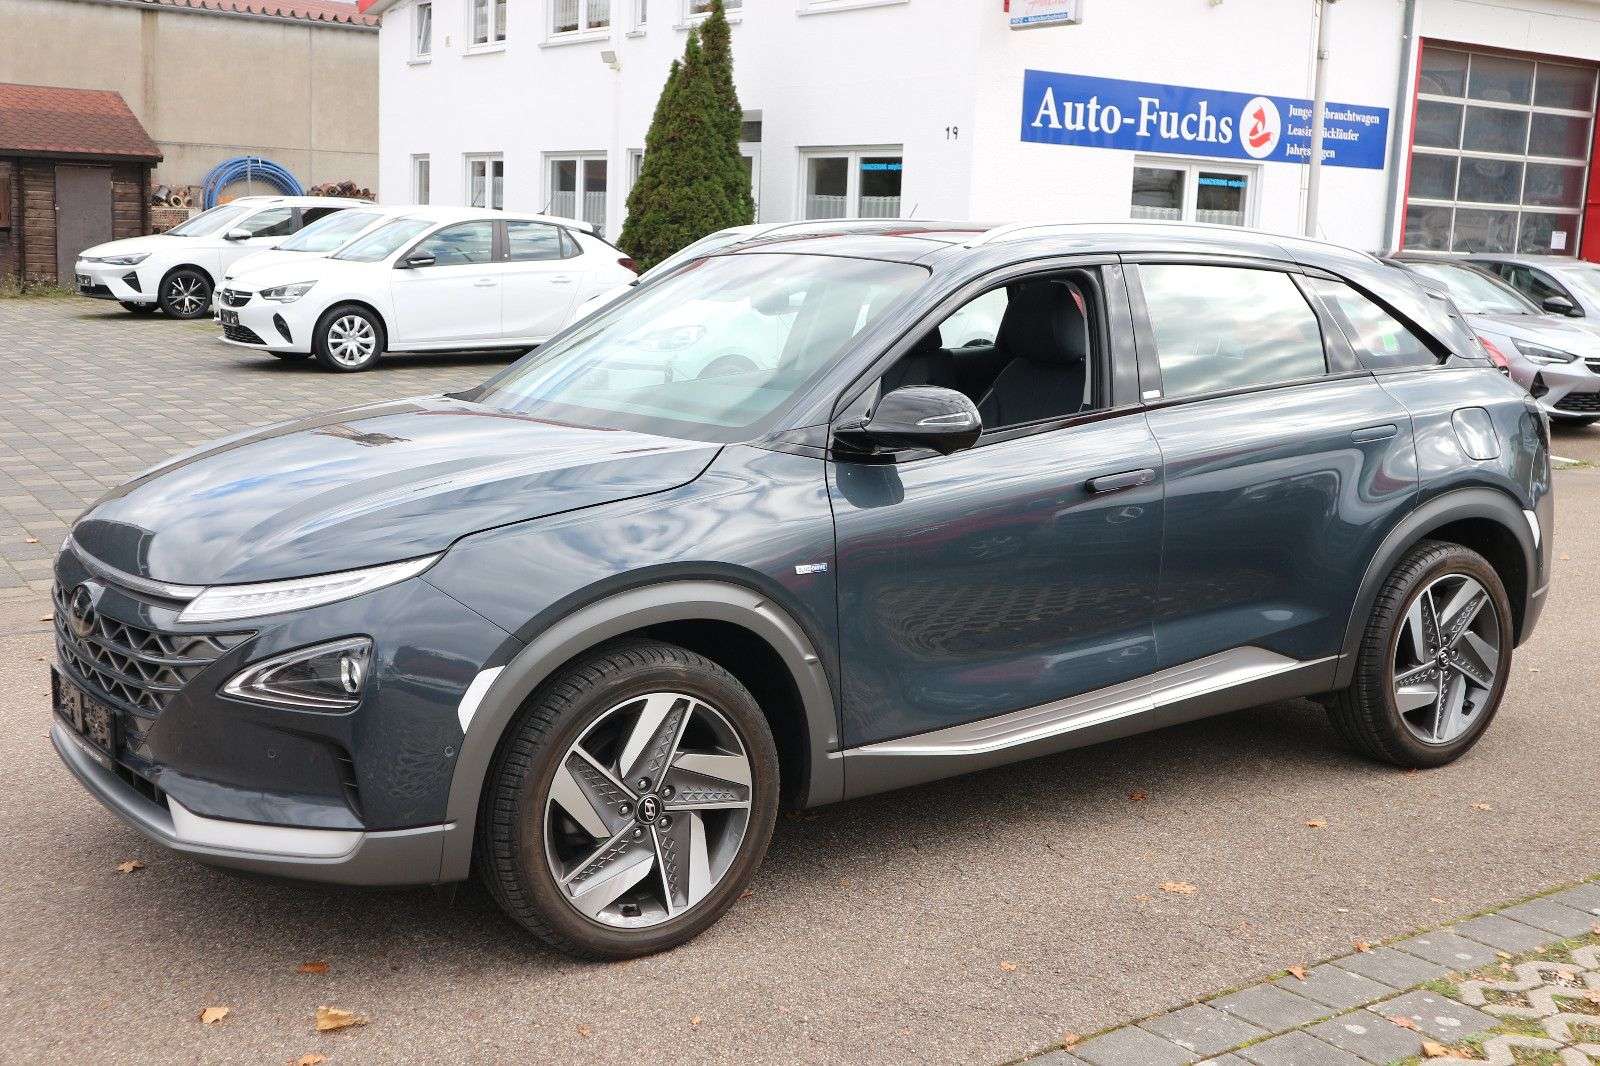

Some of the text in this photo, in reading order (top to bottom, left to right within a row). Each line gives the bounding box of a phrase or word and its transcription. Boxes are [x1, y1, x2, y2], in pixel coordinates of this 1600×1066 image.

[1031, 87, 1232, 144] Auto-Fuchs
[1289, 104, 1380, 126] Junge brauchtwagen
[945, 126, 958, 140] 19
[1286, 143, 1336, 160] Jahresgen
